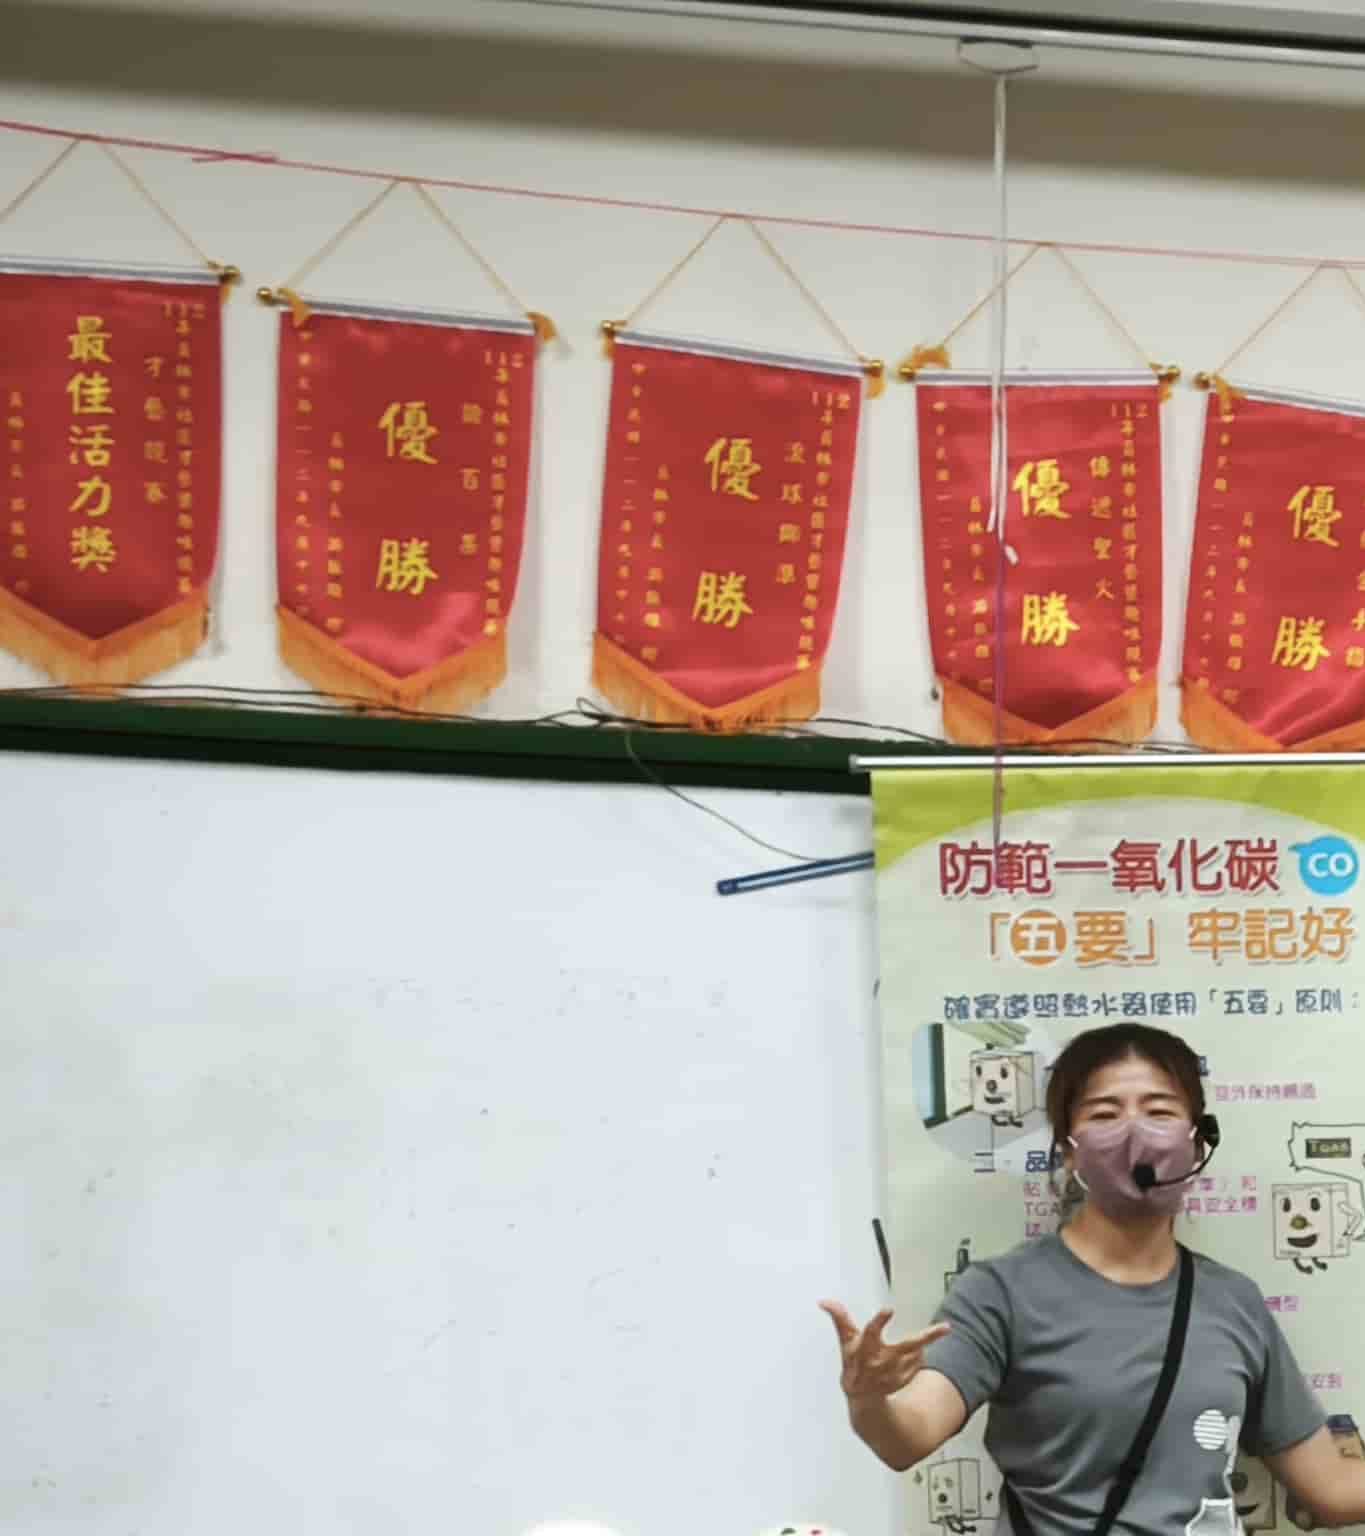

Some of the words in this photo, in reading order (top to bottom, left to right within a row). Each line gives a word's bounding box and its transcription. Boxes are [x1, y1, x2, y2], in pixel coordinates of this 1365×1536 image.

[66, 315, 117, 573] 最佳活力獎
[376, 401, 439, 596] 優勝
[692, 437, 761, 628] 優勝
[1013, 459, 1081, 647] 優勝
[1271, 484, 1341, 671] 優勝
[938, 838, 1281, 896] 防範一氧化碳
[1308, 852, 1355, 878] CO
